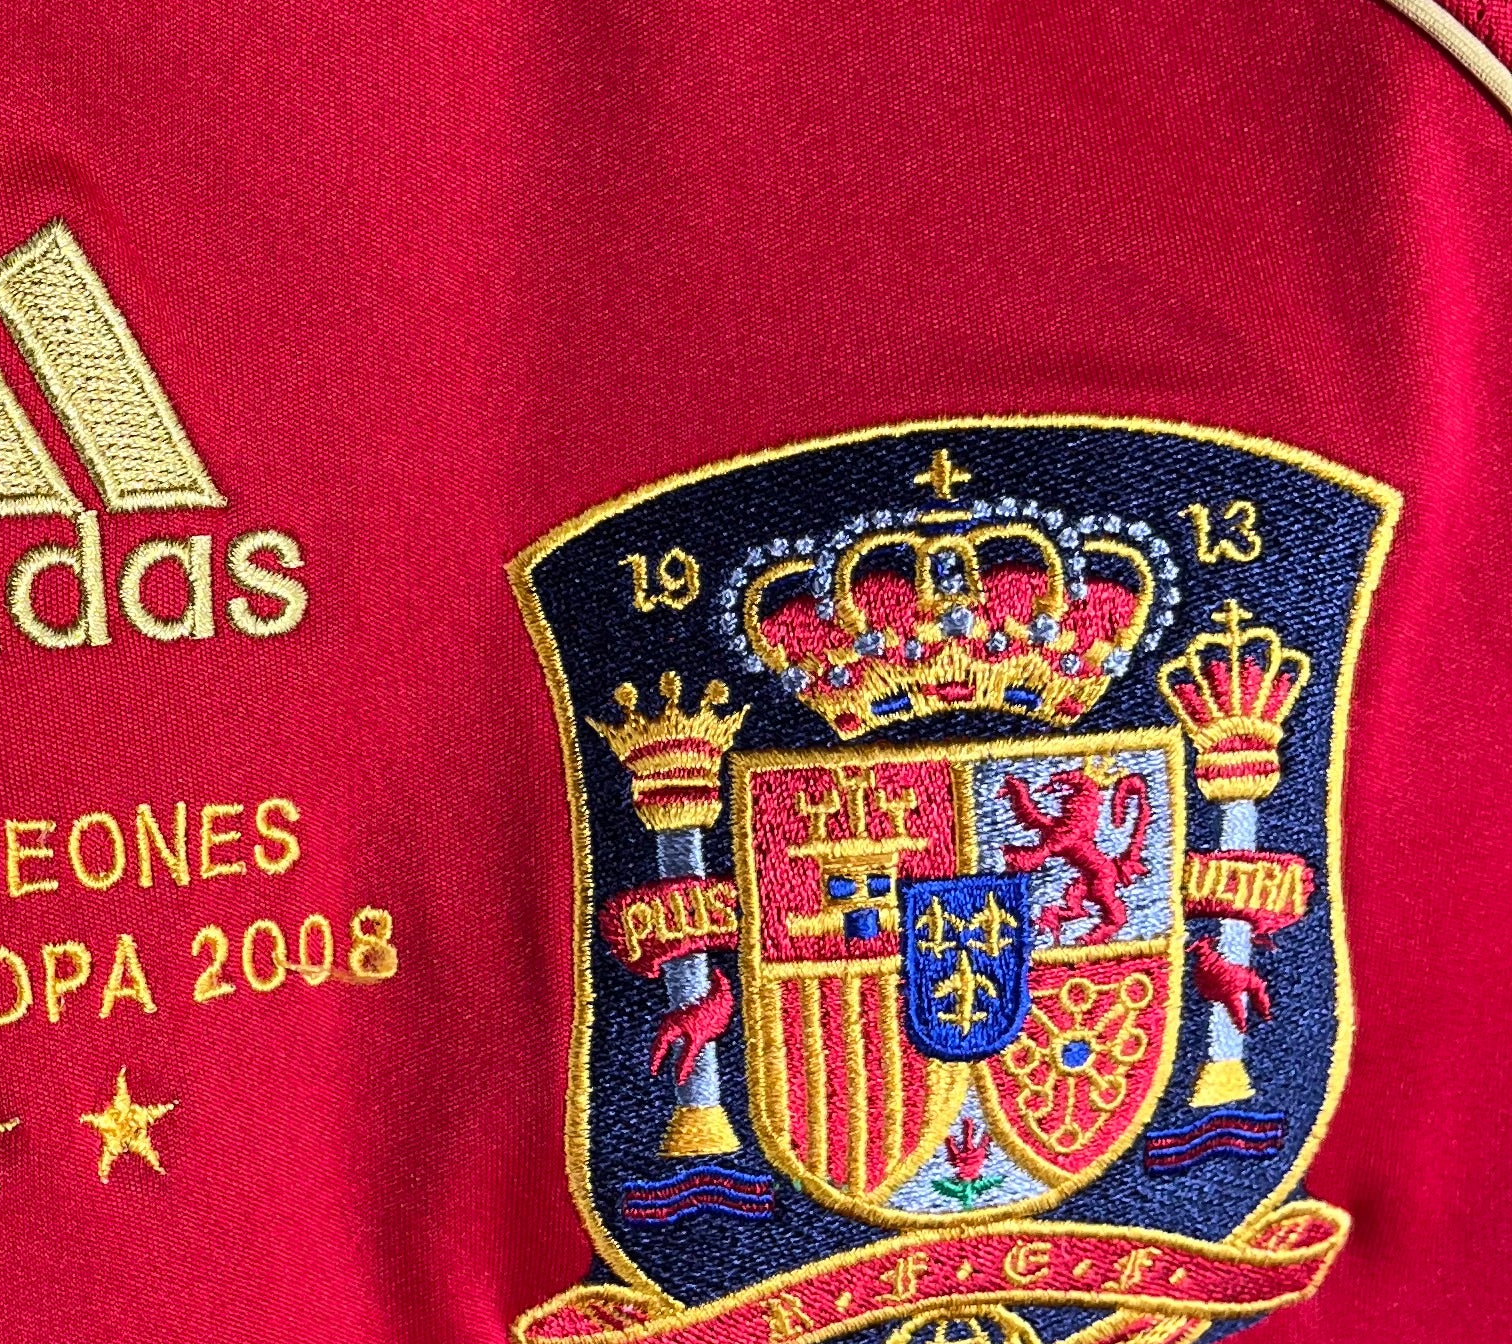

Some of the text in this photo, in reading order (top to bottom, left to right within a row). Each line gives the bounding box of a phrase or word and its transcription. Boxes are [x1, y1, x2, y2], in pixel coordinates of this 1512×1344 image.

[1177, 502, 1262, 564] 13
[617, 546, 700, 613] 19
[1184, 857, 1308, 916] ULTRA
[191, 905, 399, 1004] 2008
